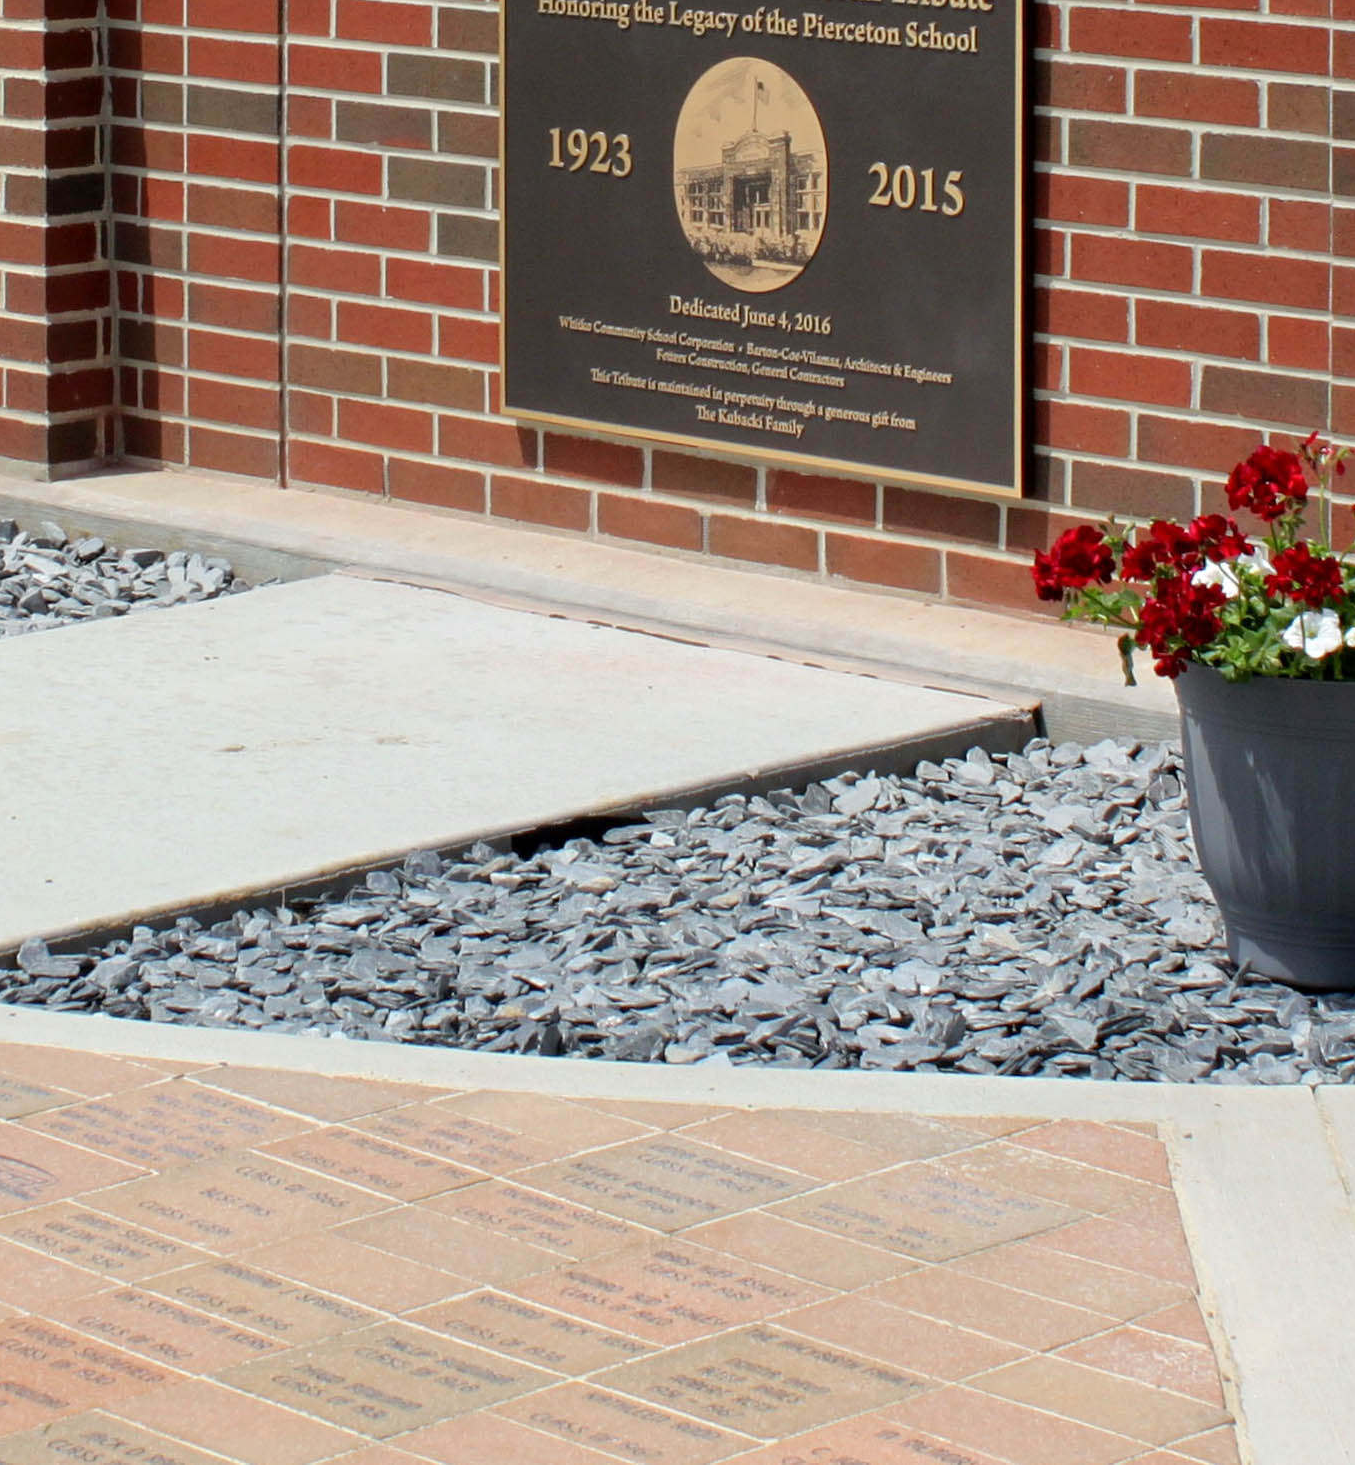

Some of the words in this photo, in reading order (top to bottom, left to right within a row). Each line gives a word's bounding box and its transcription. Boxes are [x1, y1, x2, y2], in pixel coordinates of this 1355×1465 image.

[668, 1, 737, 37] Legacy
[742, 7, 766, 33] of
[766, 9, 797, 37] the
[802, 13, 901, 46] Pierceton
[905, 20, 977, 53] School
[549, 127, 631, 177] 1923
[869, 162, 965, 217] 2015
[669, 294, 740, 323] Dedicated
[741, 305, 776, 332] June
[778, 310, 791, 333] 4,
[794, 312, 830, 335] 2016
[646, 327, 677, 344] School
[678, 331, 734, 356] Corporation
[904, 364, 952, 387] Engineers
[751, 361, 787, 379] General
[789, 367, 844, 388] Contractors
[590, 367, 610, 384] This
[612, 371, 646, 389] Tribute
[648, 376, 656, 390] is
[658, 378, 710, 399] maintained
[712, 387, 722, 401] in
[776, 395, 816, 419] through
[824, 406, 869, 427] generous
[871, 410, 889, 430] gift
[890, 412, 915, 431] from
[695, 404, 715, 422] The
[765, 415, 803, 439] Family
